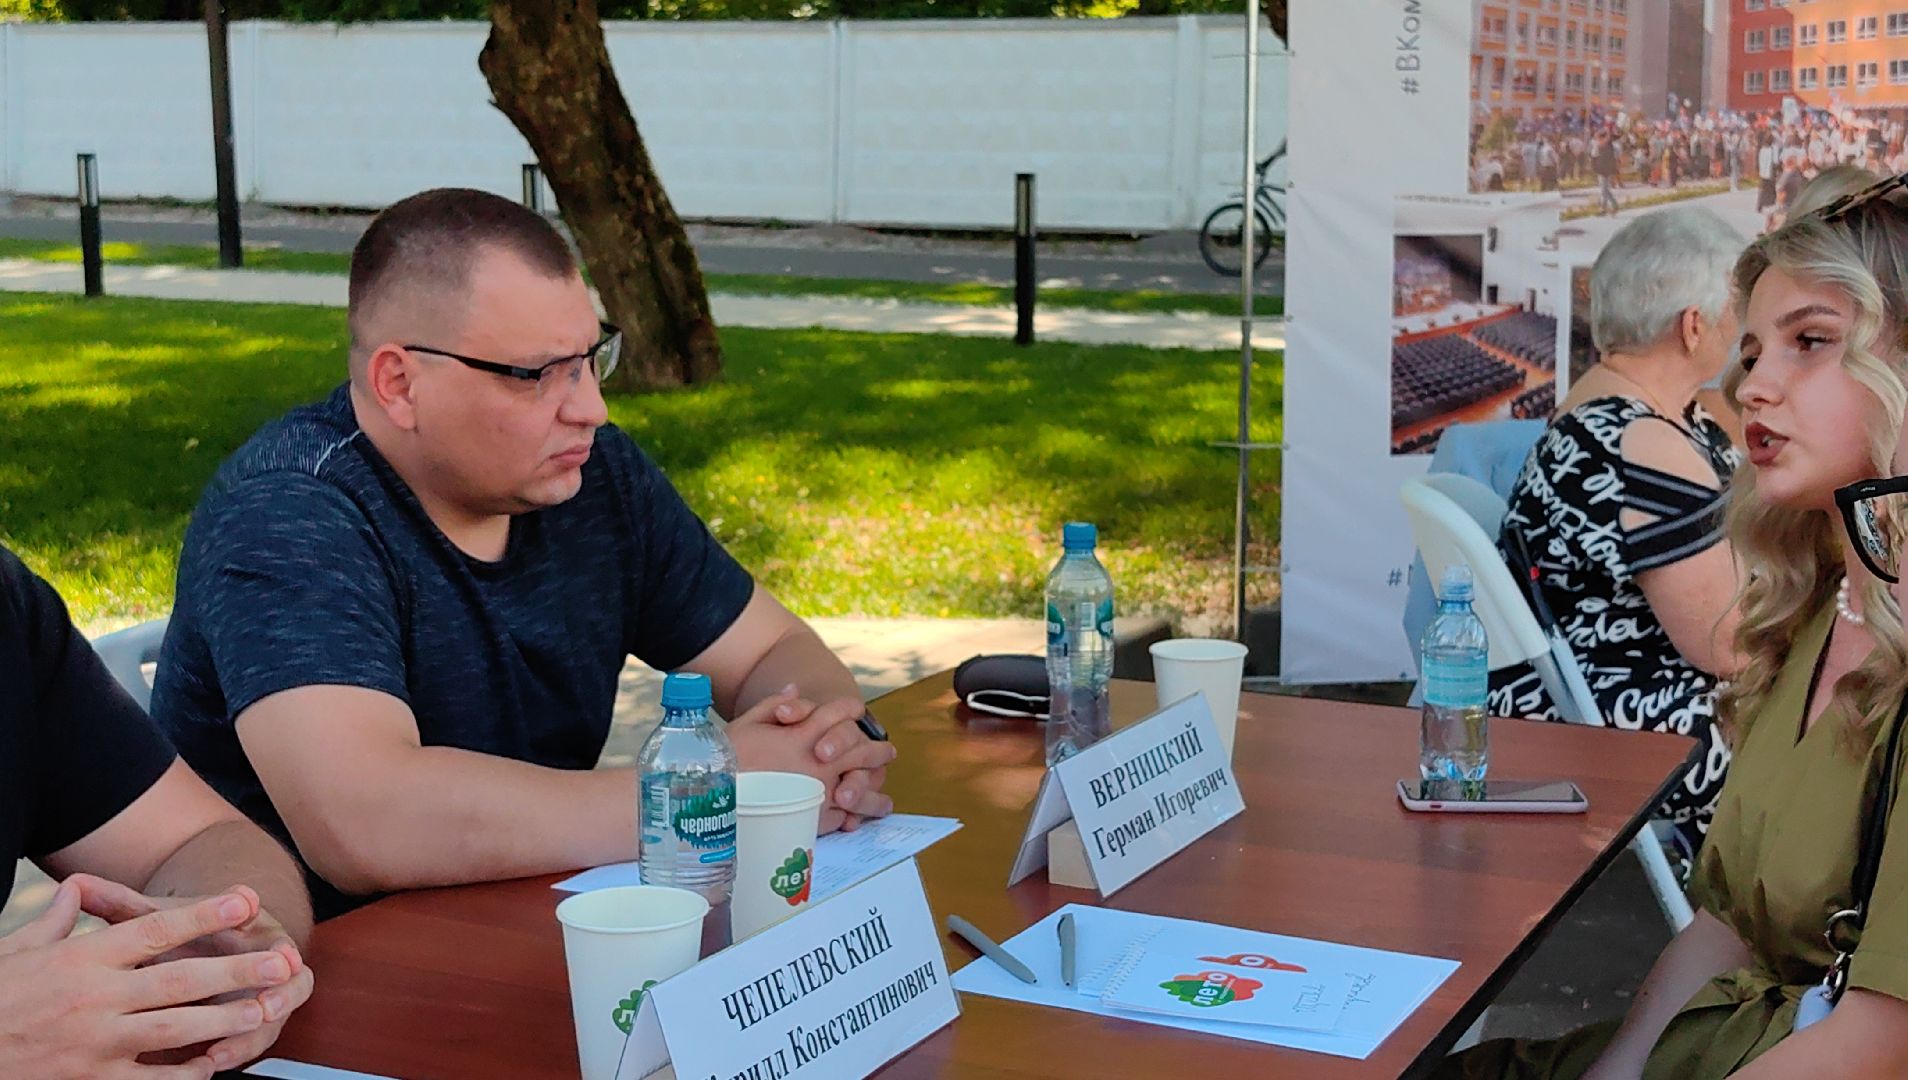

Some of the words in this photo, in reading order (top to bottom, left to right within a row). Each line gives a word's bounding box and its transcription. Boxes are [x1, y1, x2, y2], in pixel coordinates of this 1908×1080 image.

[1089, 721, 1204, 809] ВЕРНИЦКИЙ
[1092, 809, 1157, 860] Герман
[1153, 767, 1228, 824] Игоревич
[721, 906, 893, 1032] ЧЕПЕЛЕВСКИЙ
[787, 961, 938, 1070] Константинович
